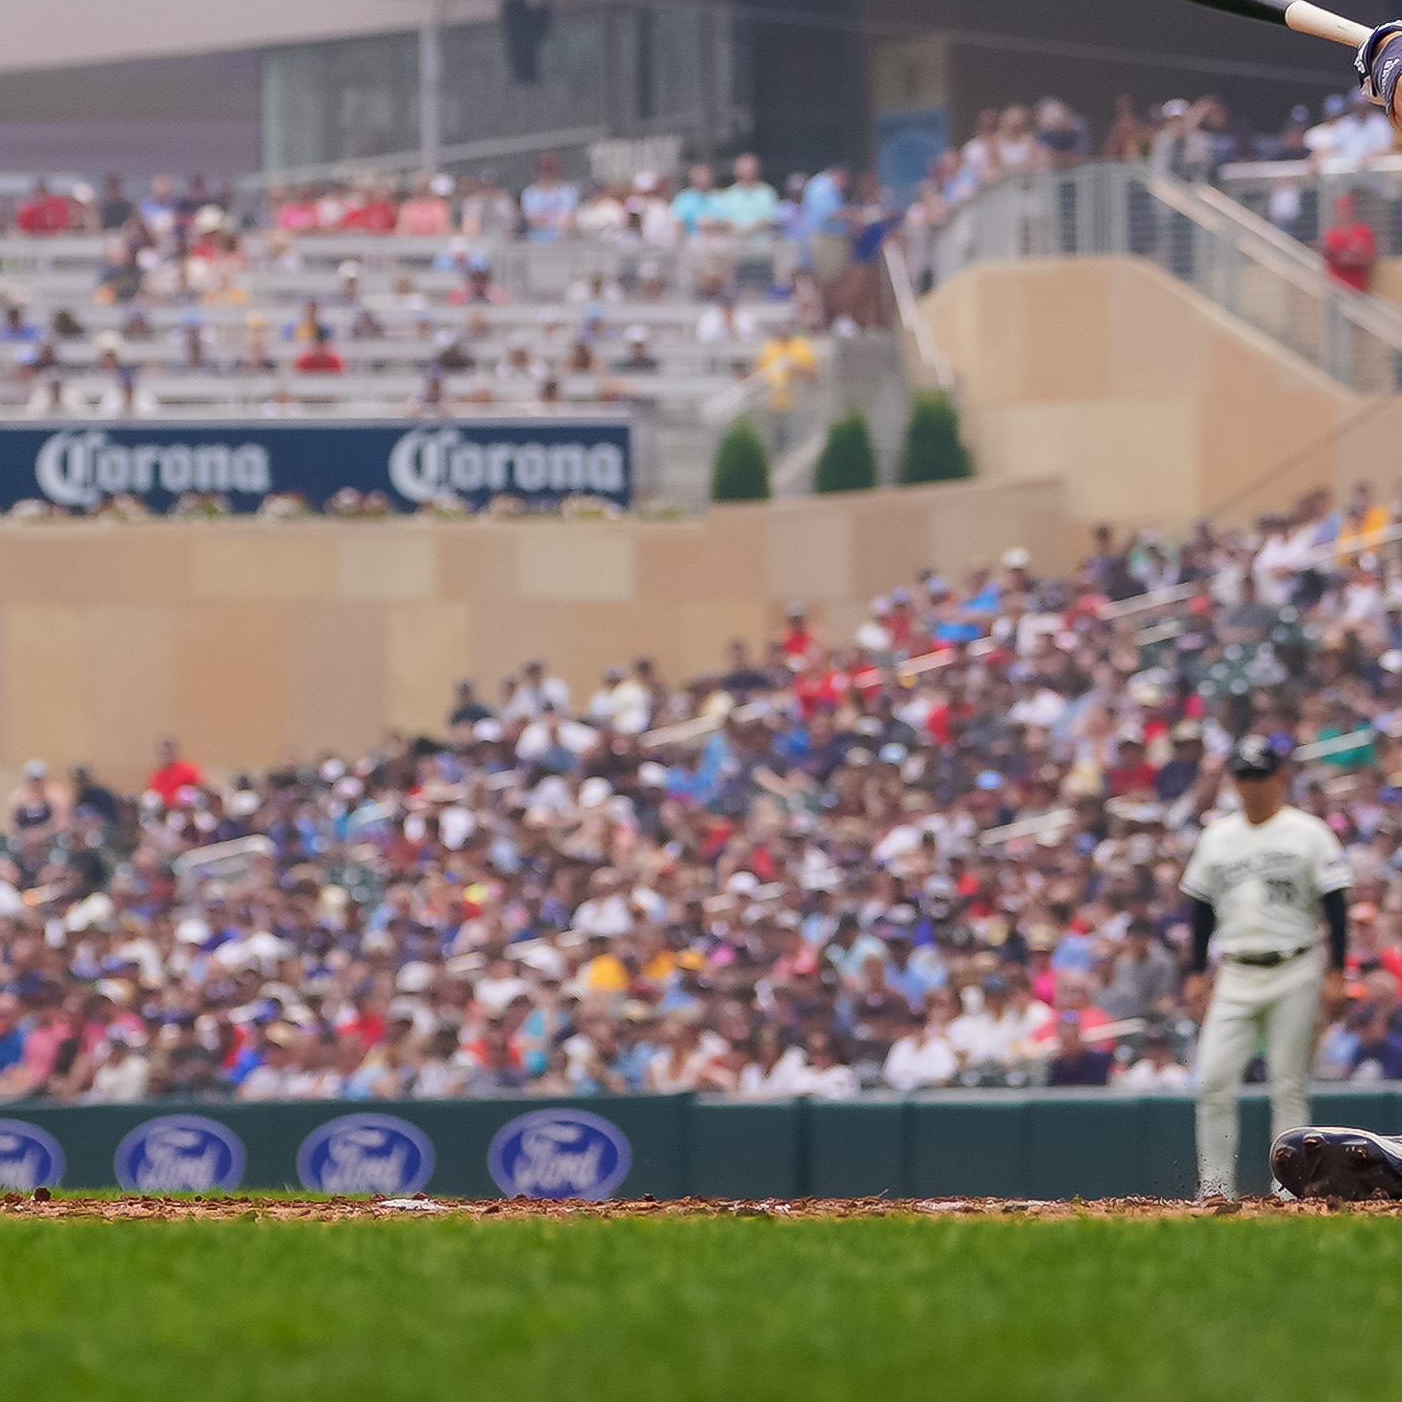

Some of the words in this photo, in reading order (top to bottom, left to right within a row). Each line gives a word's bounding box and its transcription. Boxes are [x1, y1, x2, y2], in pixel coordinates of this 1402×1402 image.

[35, 428, 271, 506] Corona
[388, 428, 625, 502] Corona
[512, 1119, 608, 1190] Ford
